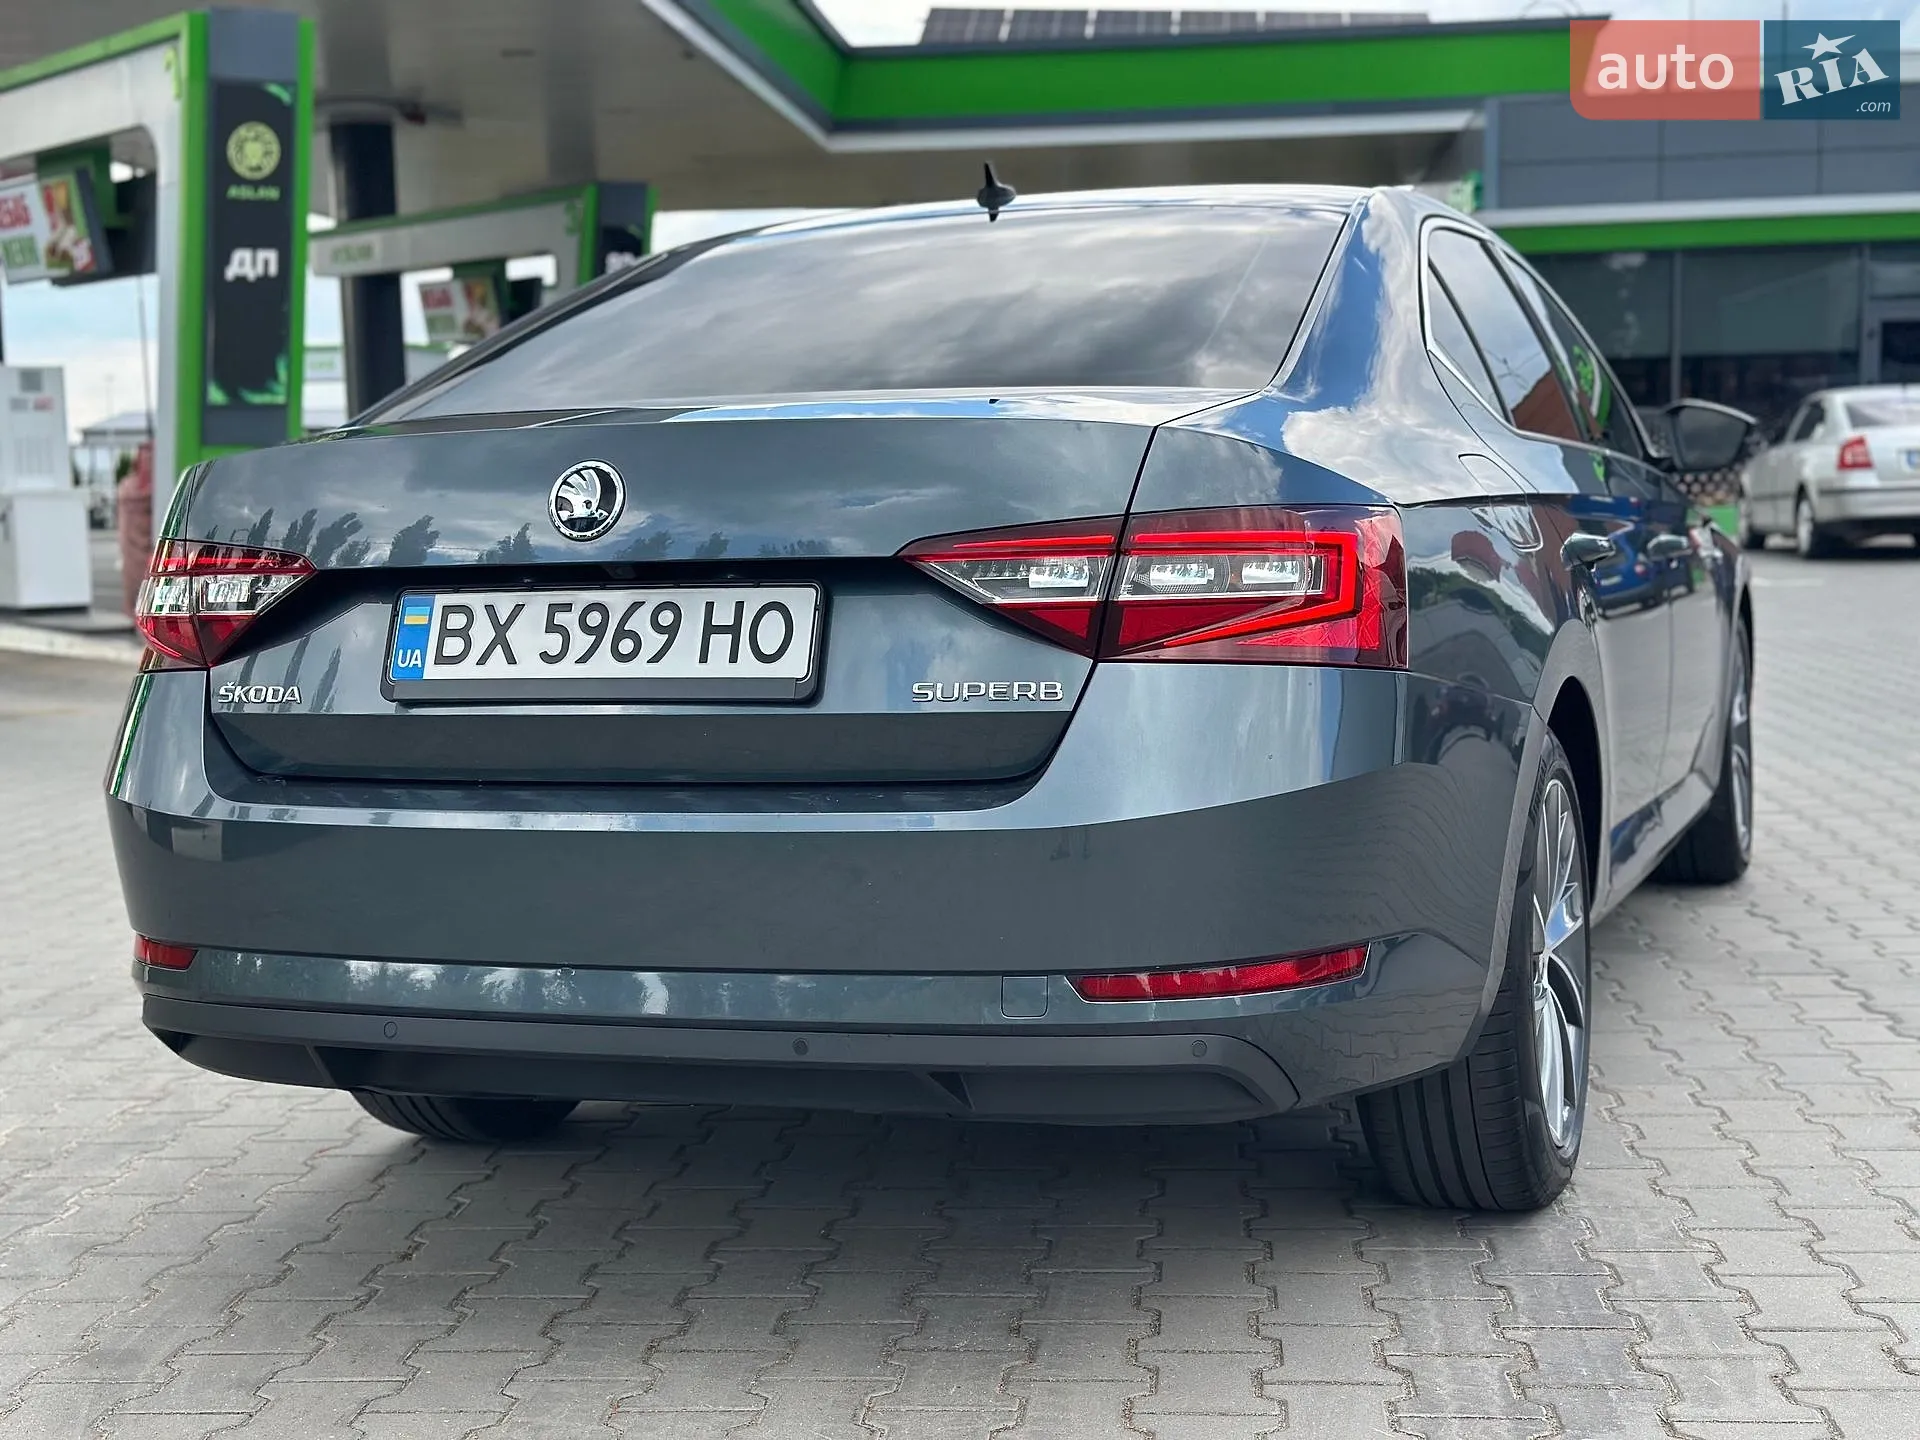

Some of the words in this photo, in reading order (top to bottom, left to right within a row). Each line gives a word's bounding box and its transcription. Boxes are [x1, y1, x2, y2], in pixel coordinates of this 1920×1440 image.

[224, 247, 280, 283] ДП
[433, 603, 526, 667] BX
[538, 600, 683, 665] 5969
[698, 600, 795, 665] HO
[397, 648, 423, 669] UA
[217, 681, 303, 704] ŠKODA
[912, 681, 1065, 703] SUPERB
